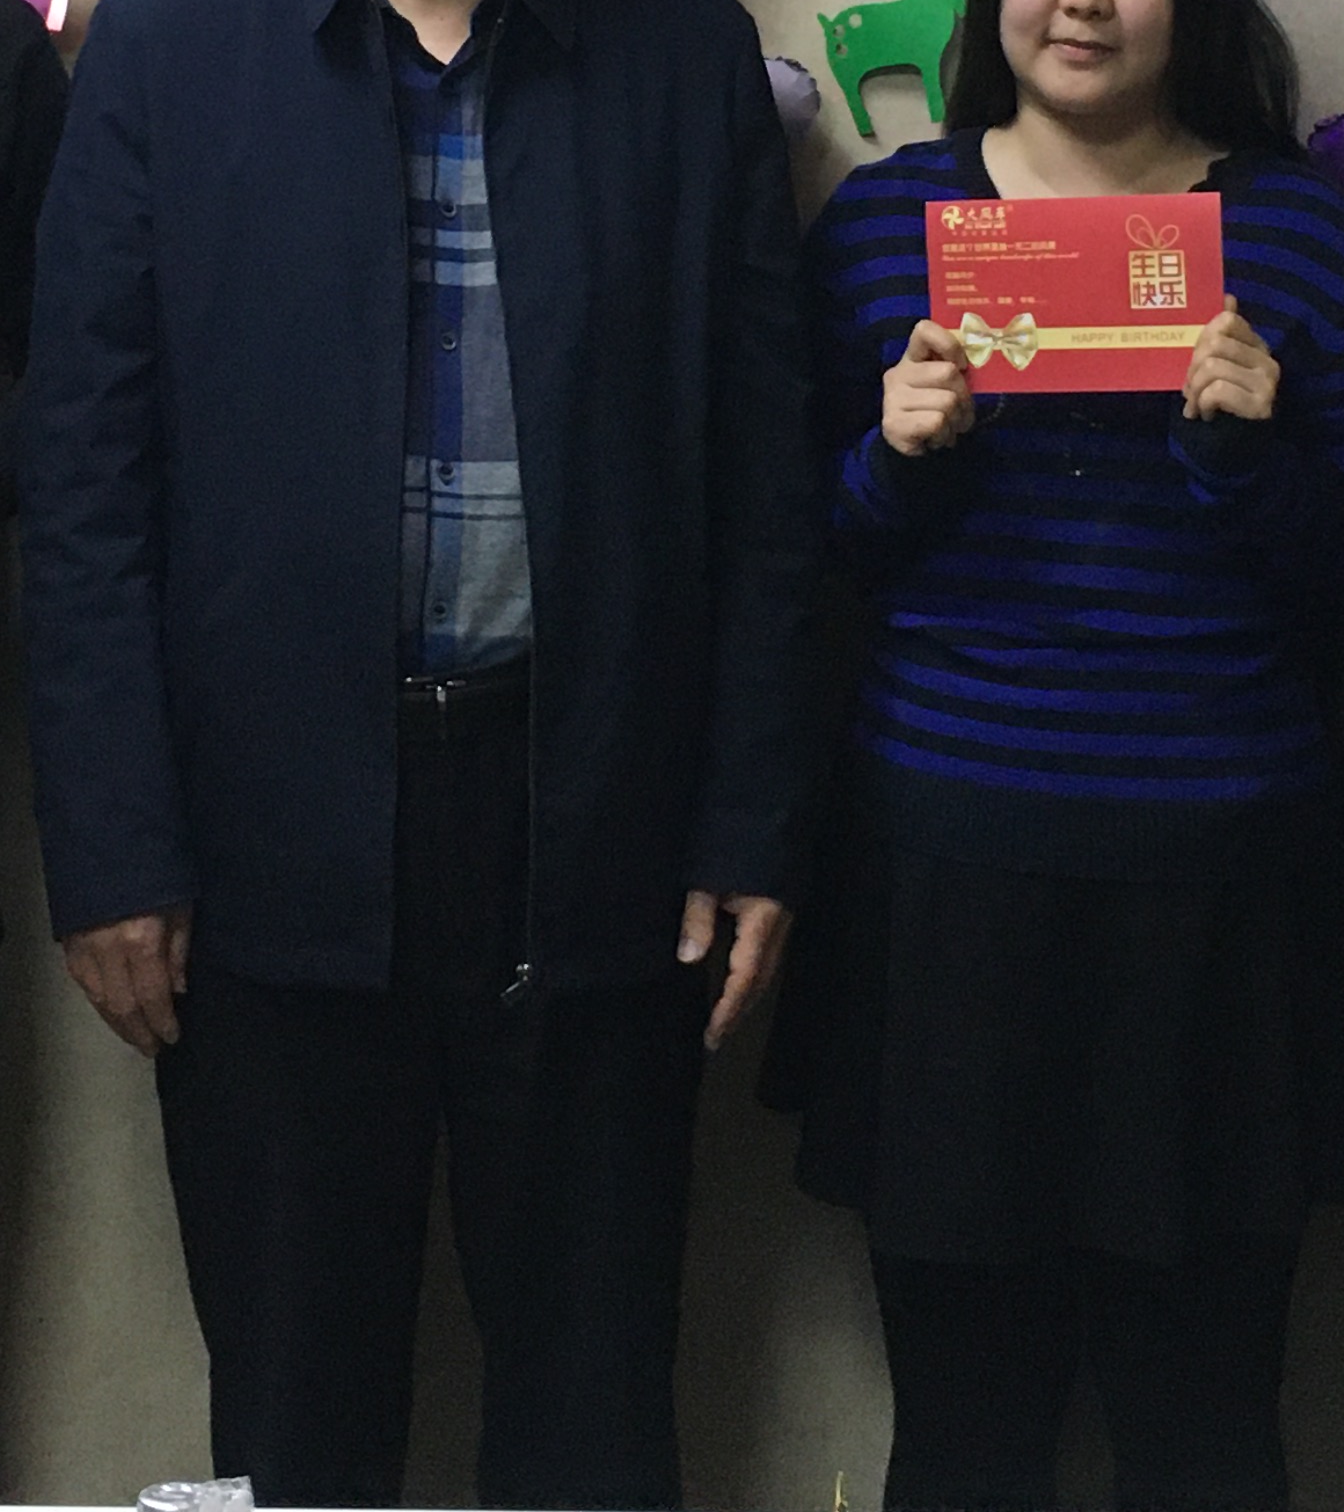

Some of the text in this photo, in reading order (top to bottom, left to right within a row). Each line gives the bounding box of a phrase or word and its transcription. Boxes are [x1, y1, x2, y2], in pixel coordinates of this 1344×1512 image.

[1131, 252, 1182, 279] 生日
[1133, 280, 1184, 306] 快乐
[1071, 330, 1186, 344] HAPPY BIRTHDAY
